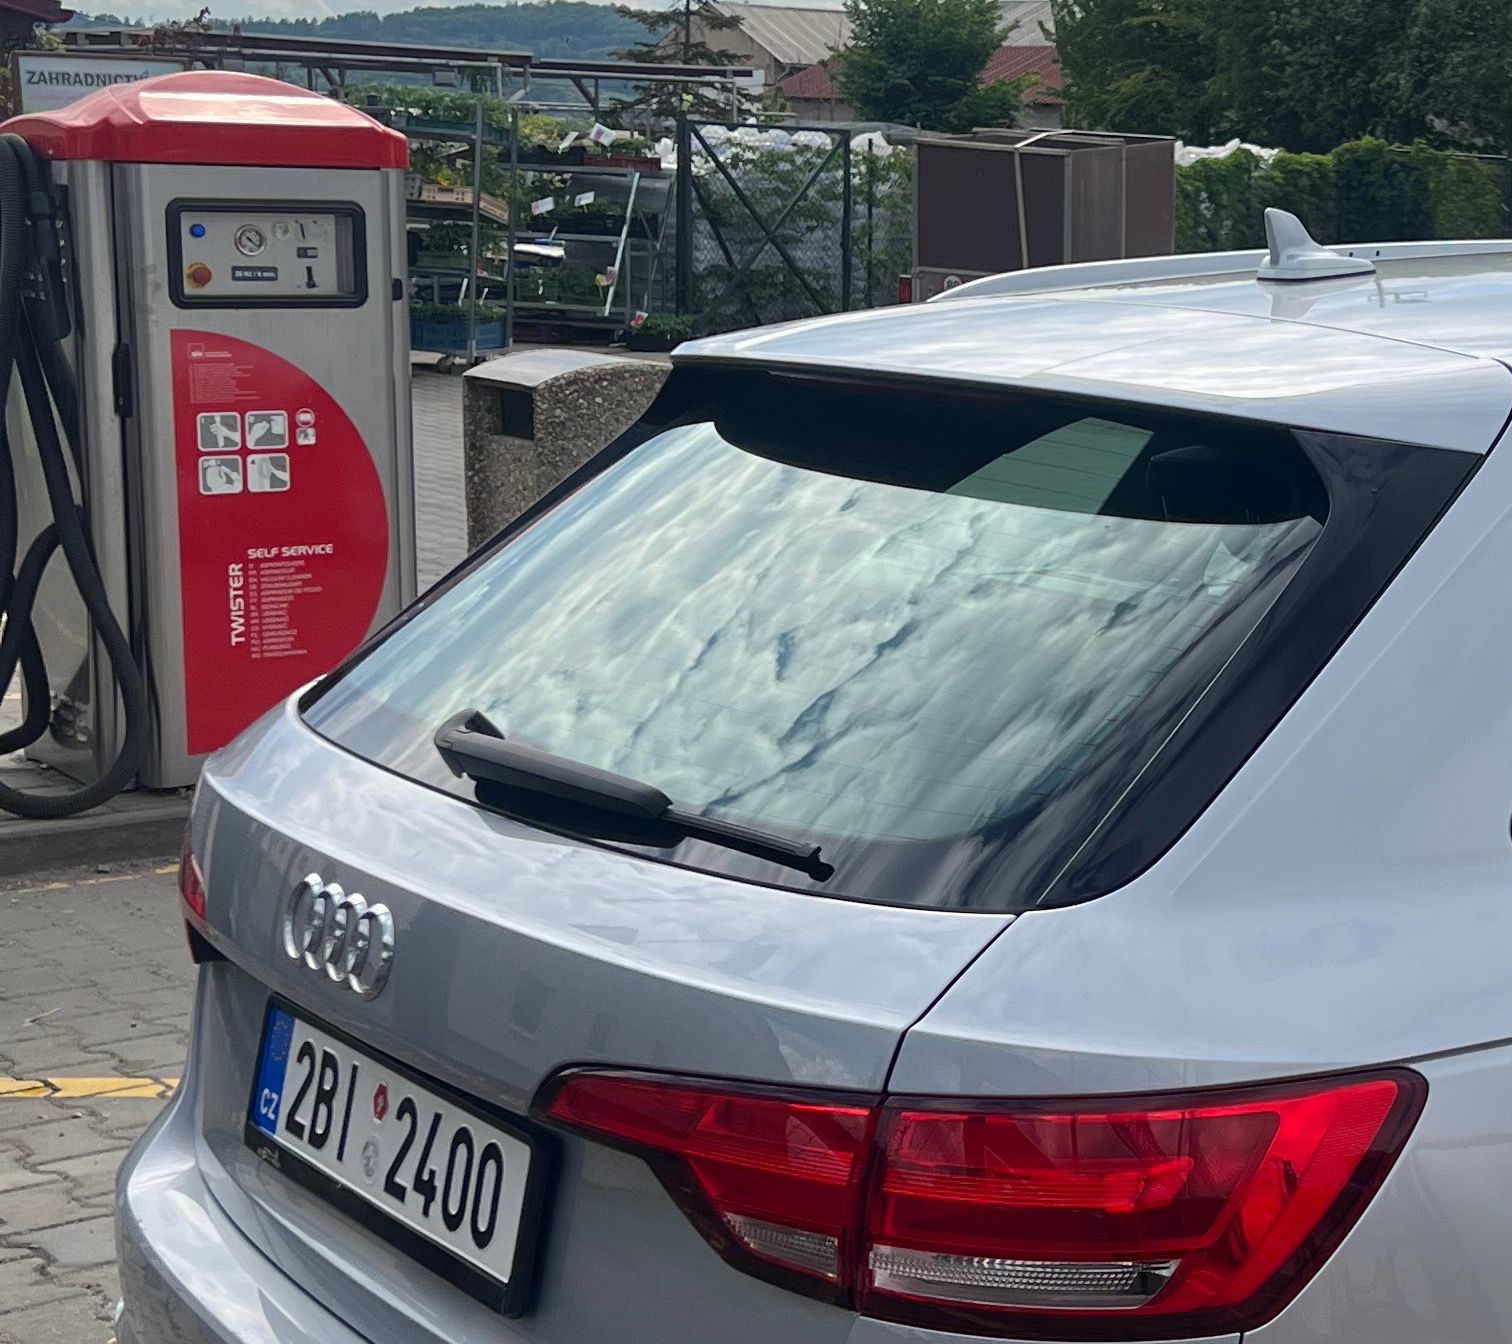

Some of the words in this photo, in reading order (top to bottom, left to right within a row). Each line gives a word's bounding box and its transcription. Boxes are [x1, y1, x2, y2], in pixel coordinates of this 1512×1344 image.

[247, 547, 280, 559] SELF
[281, 543, 334, 557] SERVICE
[228, 563, 246, 646] TWISTER
[259, 1087, 279, 1121] CZ
[384, 1096, 504, 1250] 2400
